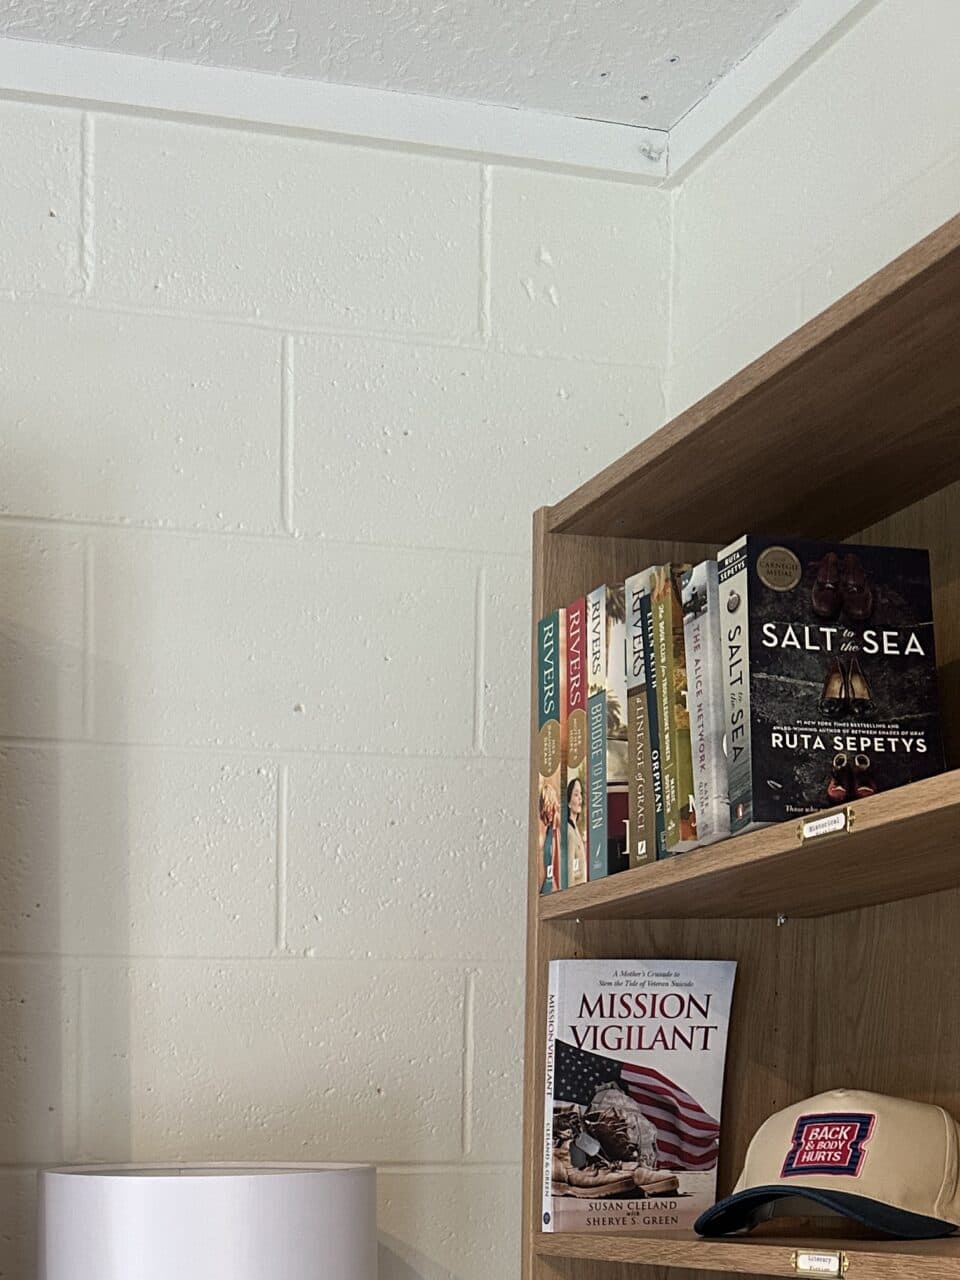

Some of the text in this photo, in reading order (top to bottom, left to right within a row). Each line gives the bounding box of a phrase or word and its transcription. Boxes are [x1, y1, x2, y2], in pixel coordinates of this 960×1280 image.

[719, 561, 746, 582] SEPETYS
[592, 599, 602, 677] RIVERS
[762, 623, 926, 656] SALT to the SEA
[543, 622, 555, 715] RIVERS
[570, 610, 581, 707] RIVERS
[693, 626, 706, 772] THE ALICE NETWORK
[728, 625, 745, 762] SALT SEA
[771, 733, 928, 753] RUTA SEPETYS
[577, 992, 713, 1019] MISSION
[569, 1025, 718, 1051] VIGILANT
[809, 1125, 851, 1140] BACK
[801, 1150, 842, 1162] HURTS
[805, 1140, 846, 1150] & BODY
[588, 1201, 678, 1212] SUSAN CLELAND
[586, 1217, 628, 1226] SHERYE
[642, 1215, 679, 1226] GREEN
